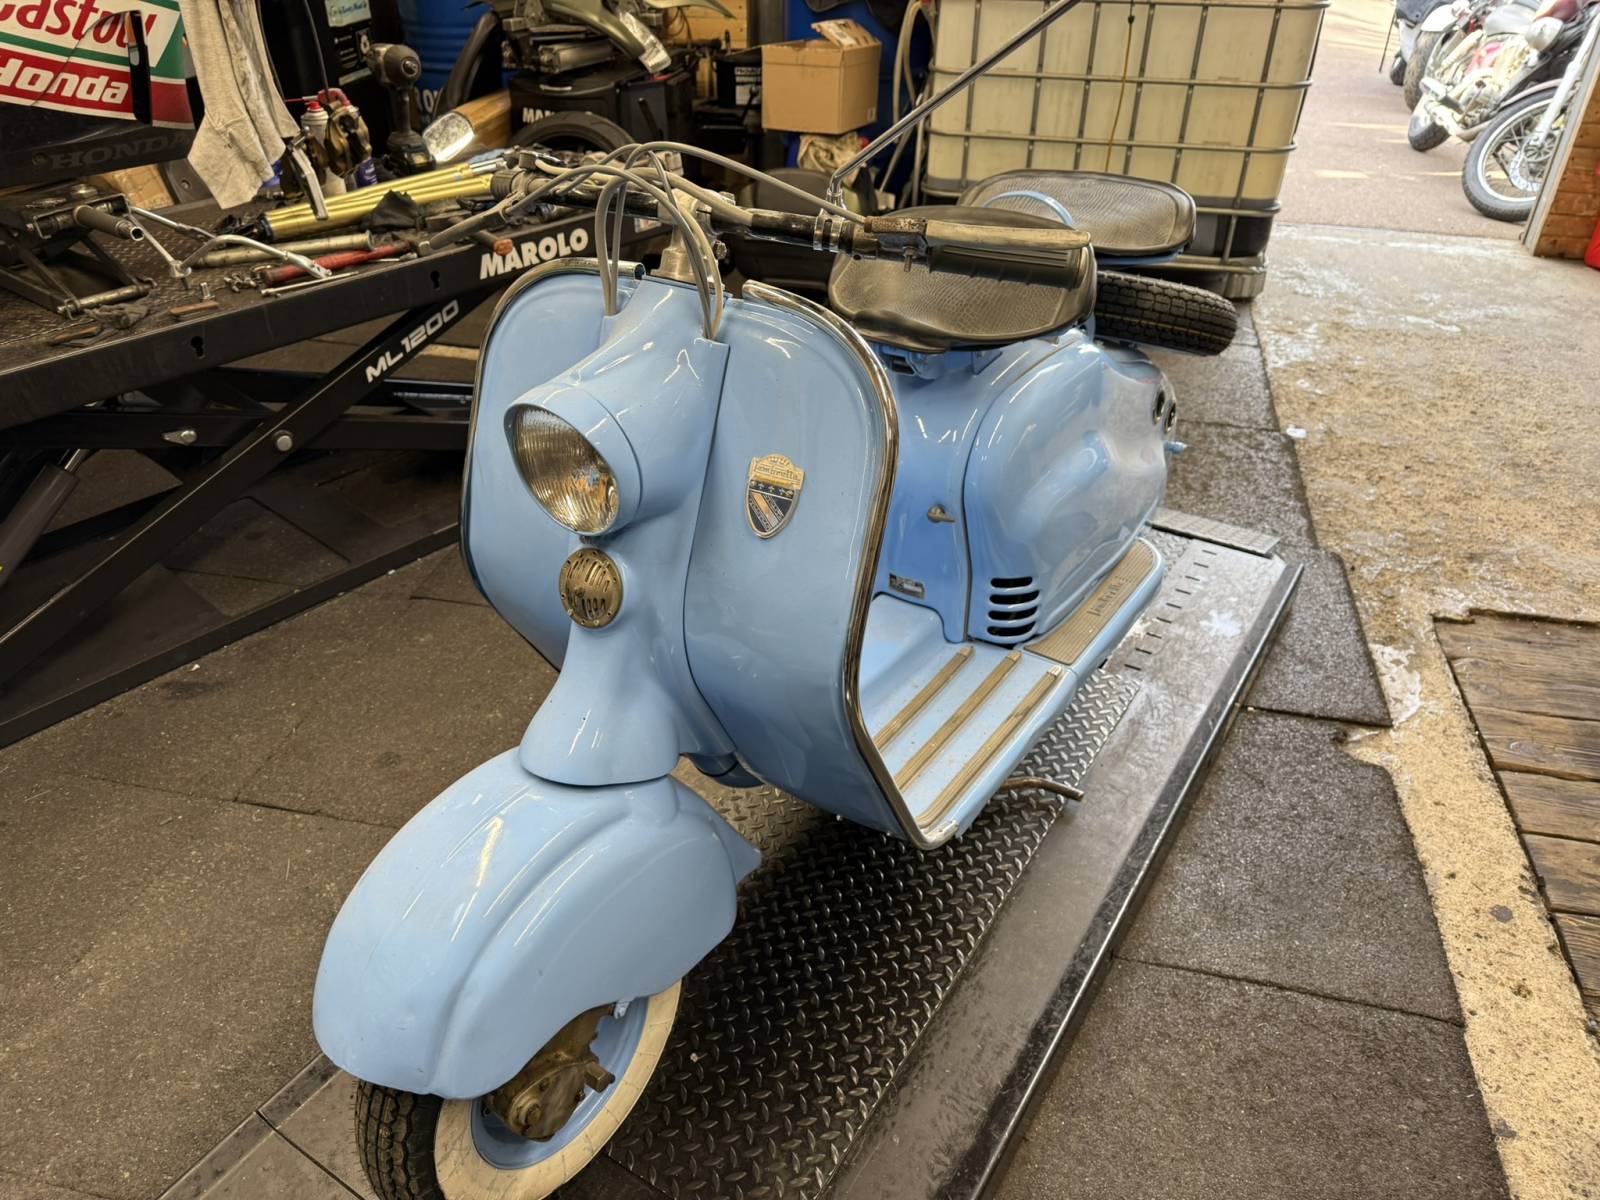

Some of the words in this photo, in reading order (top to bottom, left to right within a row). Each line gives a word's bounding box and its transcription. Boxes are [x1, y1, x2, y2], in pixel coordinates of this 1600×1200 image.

[0, 58, 129, 105] Honda
[49, 132, 192, 169] HONDA
[480, 228, 589, 280] MAROLO
[401, 299, 459, 353] 1200
